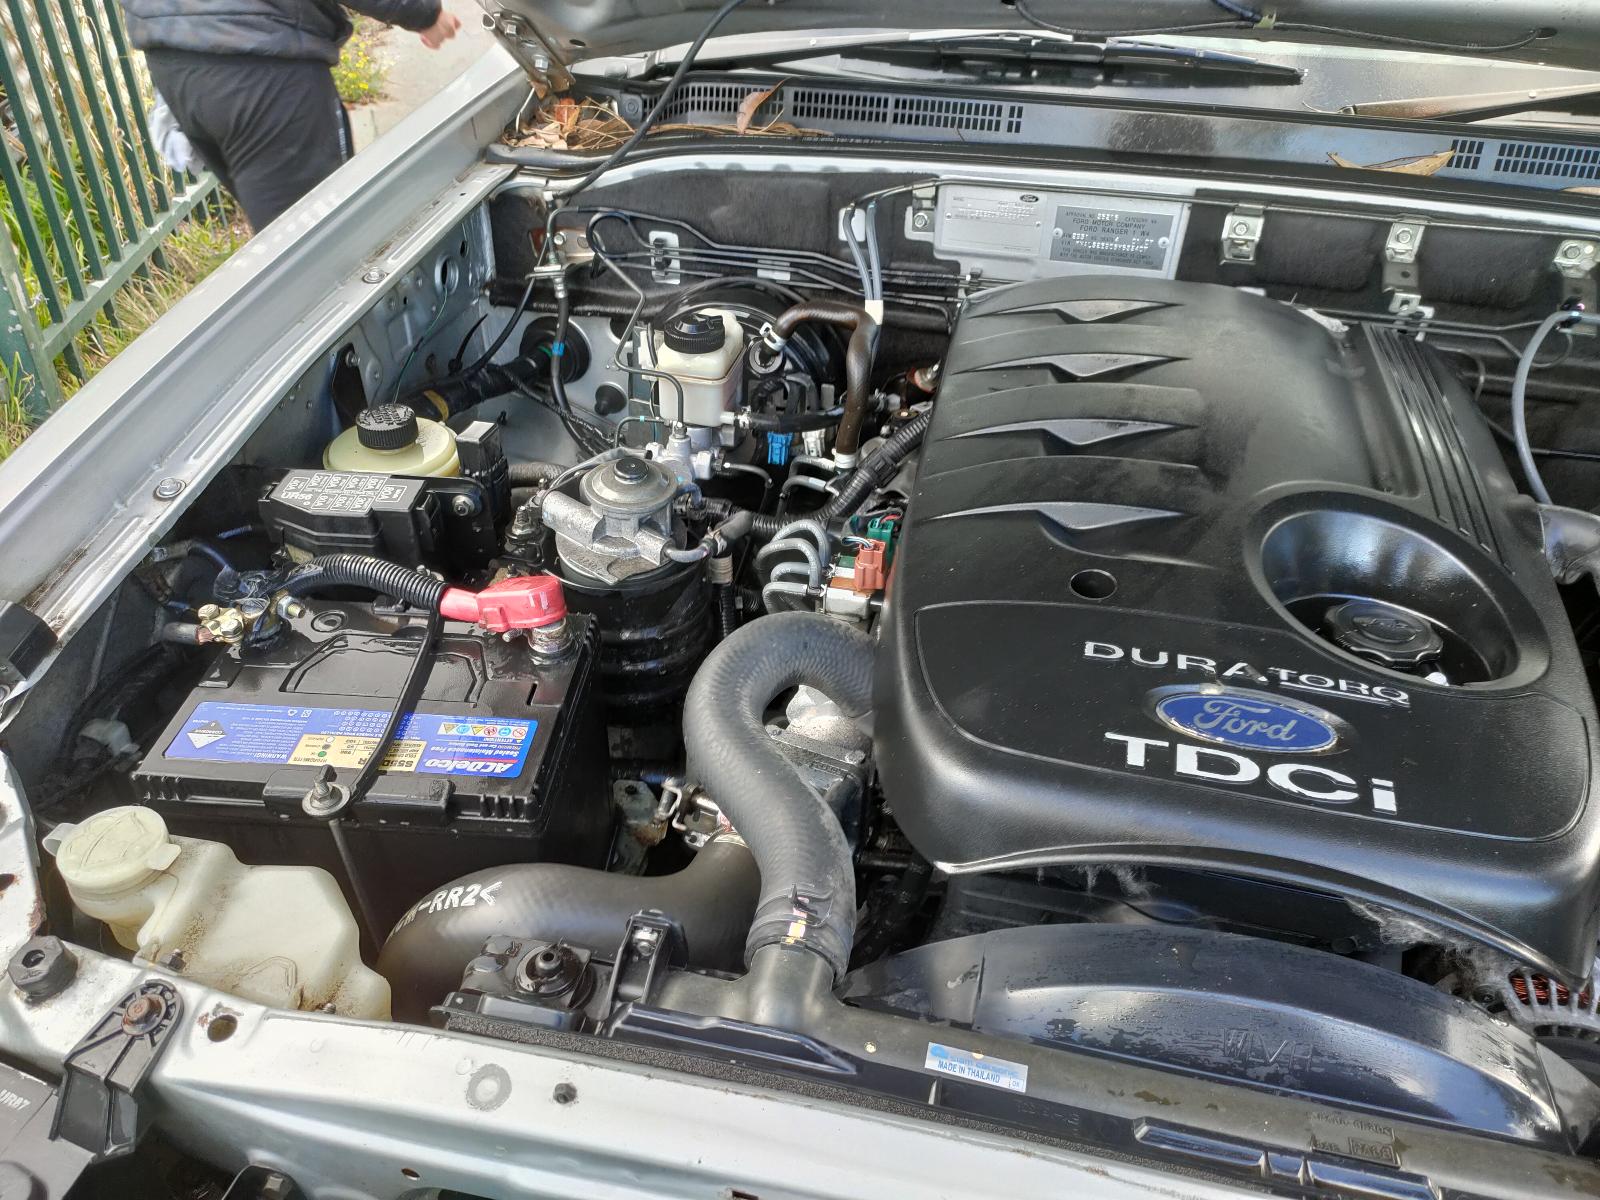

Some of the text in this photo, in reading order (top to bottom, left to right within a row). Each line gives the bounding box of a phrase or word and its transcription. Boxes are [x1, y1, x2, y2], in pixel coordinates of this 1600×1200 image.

[1079, 224, 1097, 232] FORD
[1101, 226, 1128, 234] RANGER
[1116, 221, 1145, 229] COMPANY
[1192, 699, 1297, 742] Ford
[424, 759, 514, 774] ACDelco
[1103, 730, 1399, 815] TDCi
[937, 1060, 1001, 1084] MADE IN THAILAND
